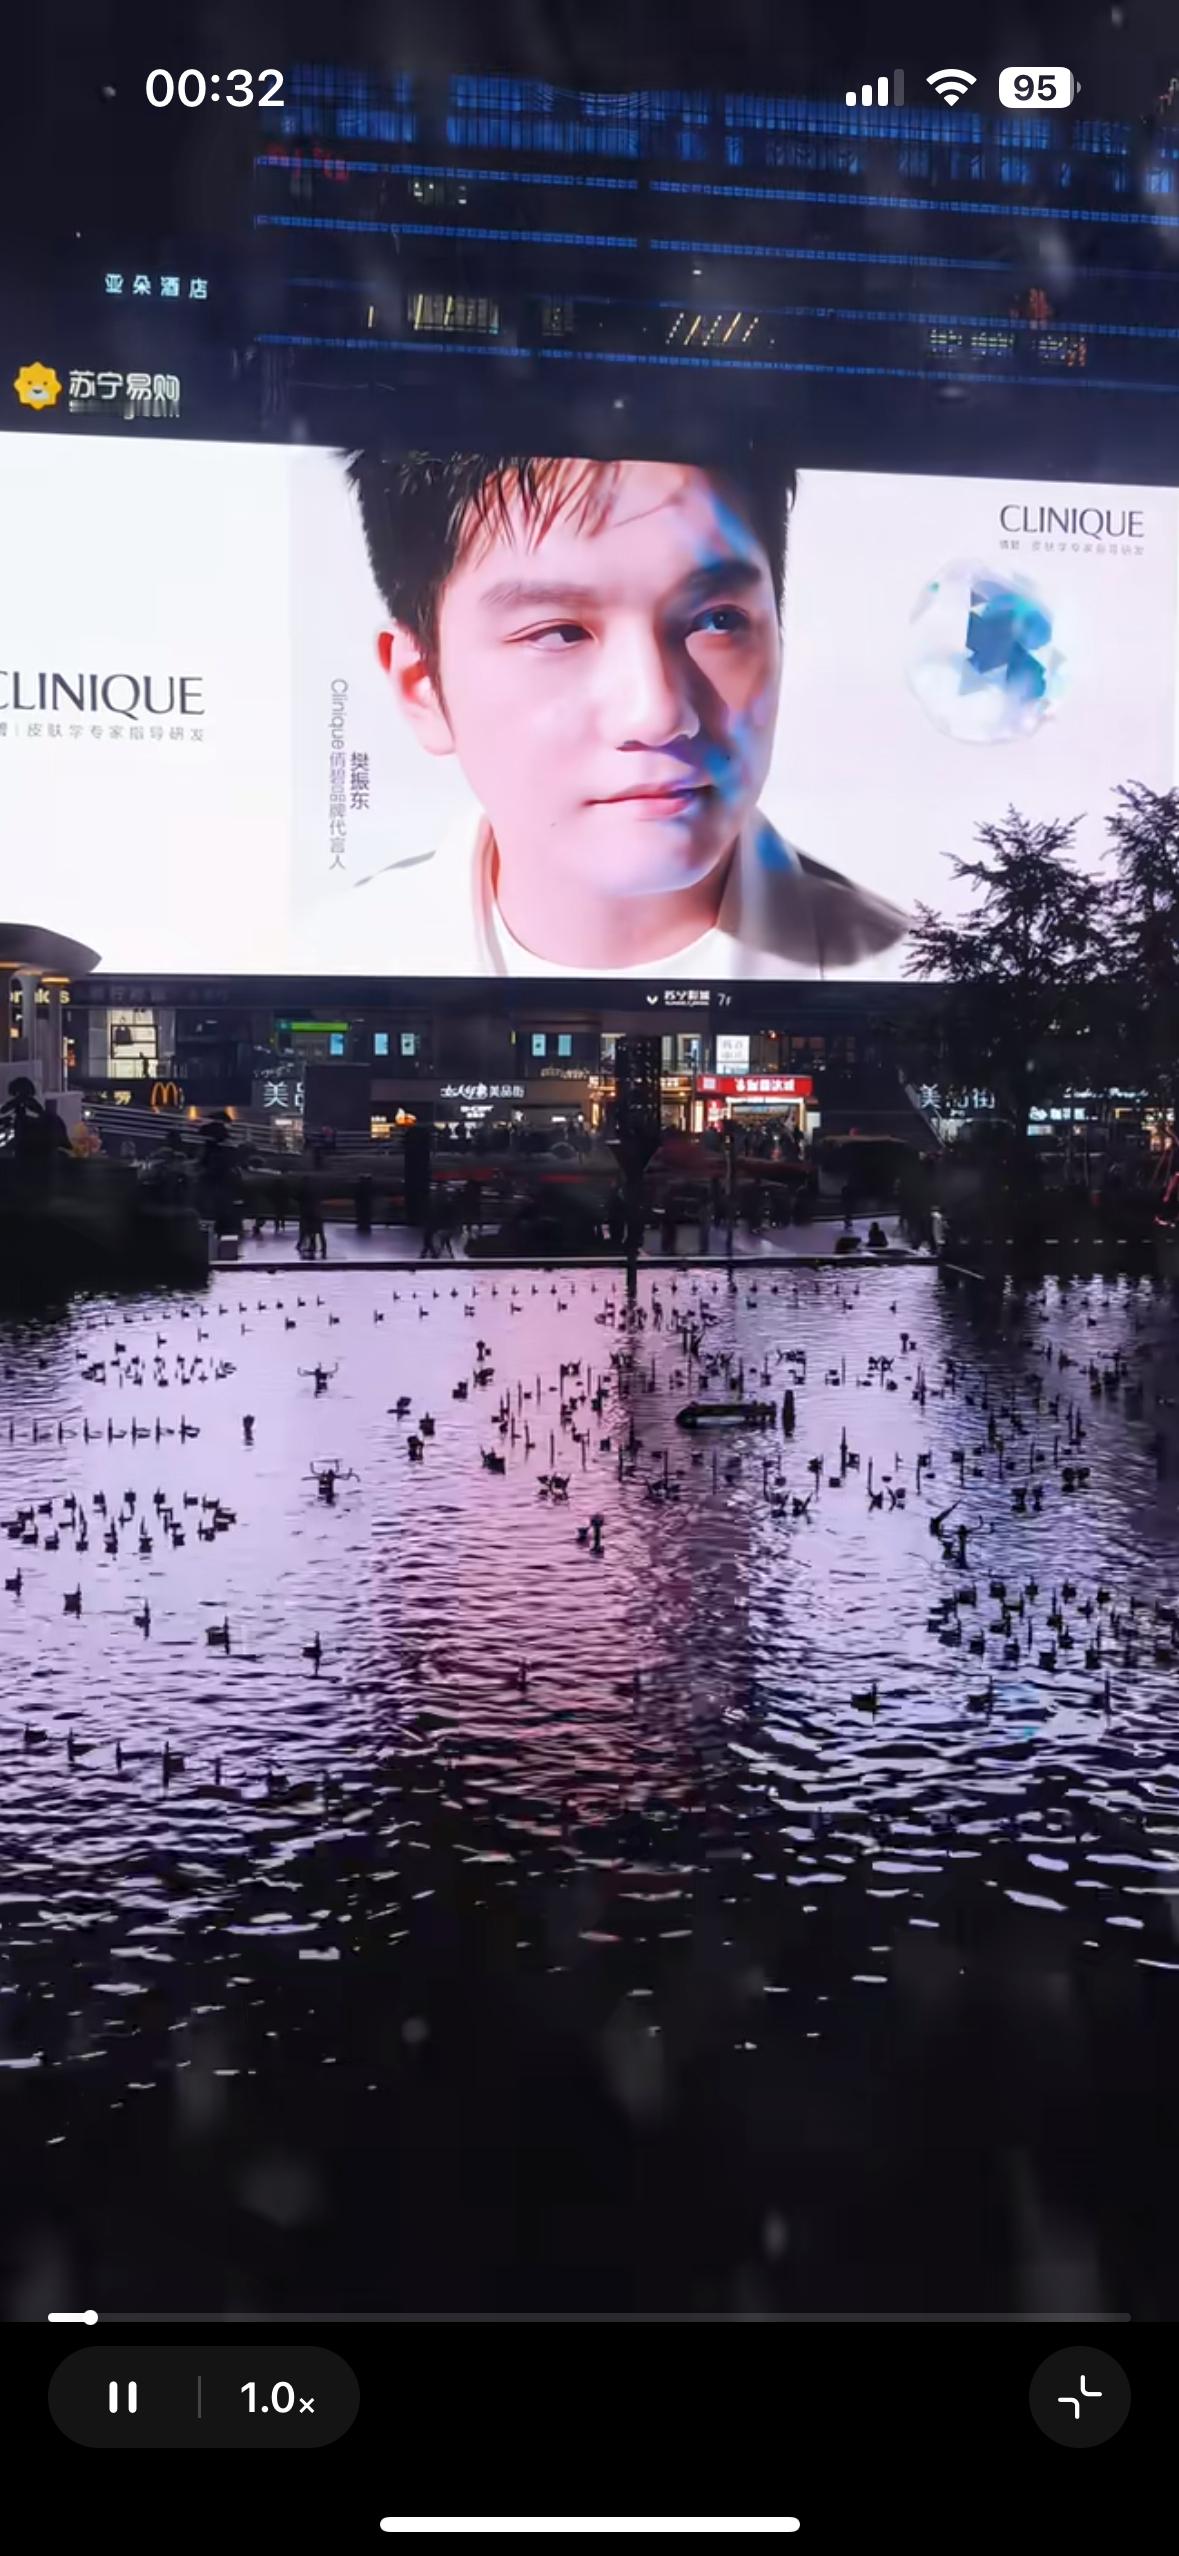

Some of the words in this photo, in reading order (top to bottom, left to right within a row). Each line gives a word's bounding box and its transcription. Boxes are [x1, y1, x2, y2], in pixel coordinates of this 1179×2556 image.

[104, 273, 208, 300] 亚朵酒店
[69, 370, 180, 402] 苏宁易购
[999, 504, 1144, 541] CLINIQUE
[0, 671, 205, 721] LINIQUE
[350, 751, 370, 810] 樊振东
